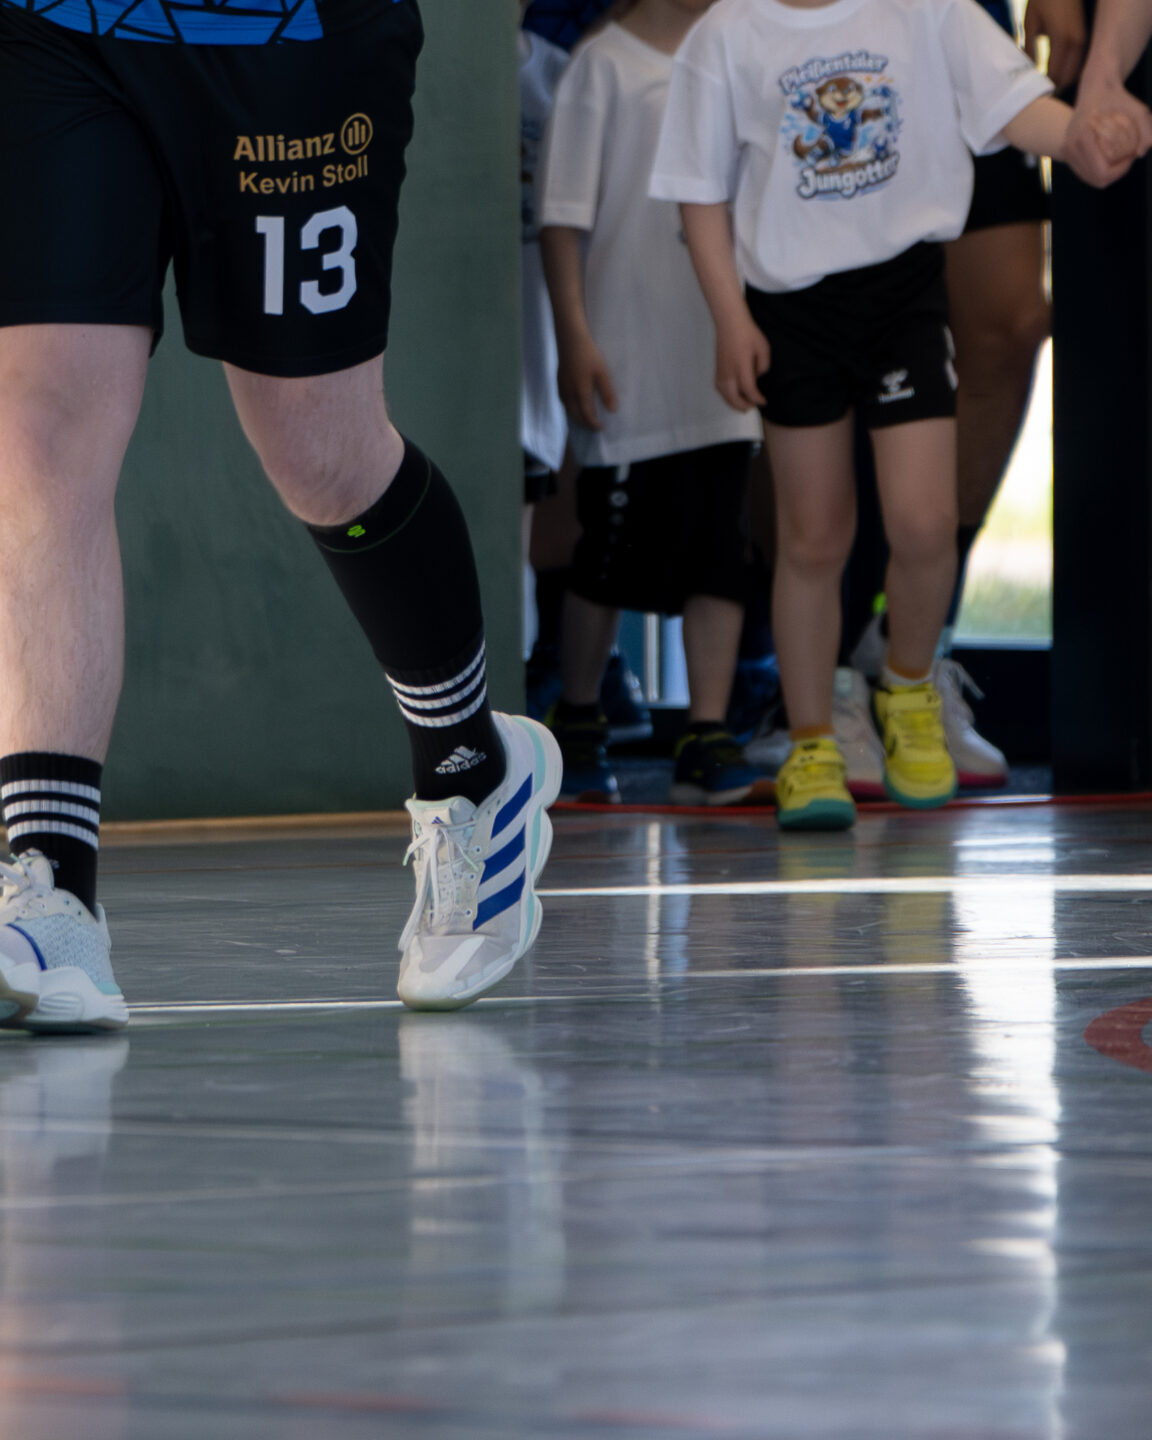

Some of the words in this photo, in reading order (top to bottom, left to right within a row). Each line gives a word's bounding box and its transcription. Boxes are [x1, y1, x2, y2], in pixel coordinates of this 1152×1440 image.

[233, 133, 336, 162] Allianz
[239, 170, 314, 195] Kevin
[322, 154, 369, 188] Stoll
[256, 205, 359, 317] 13
